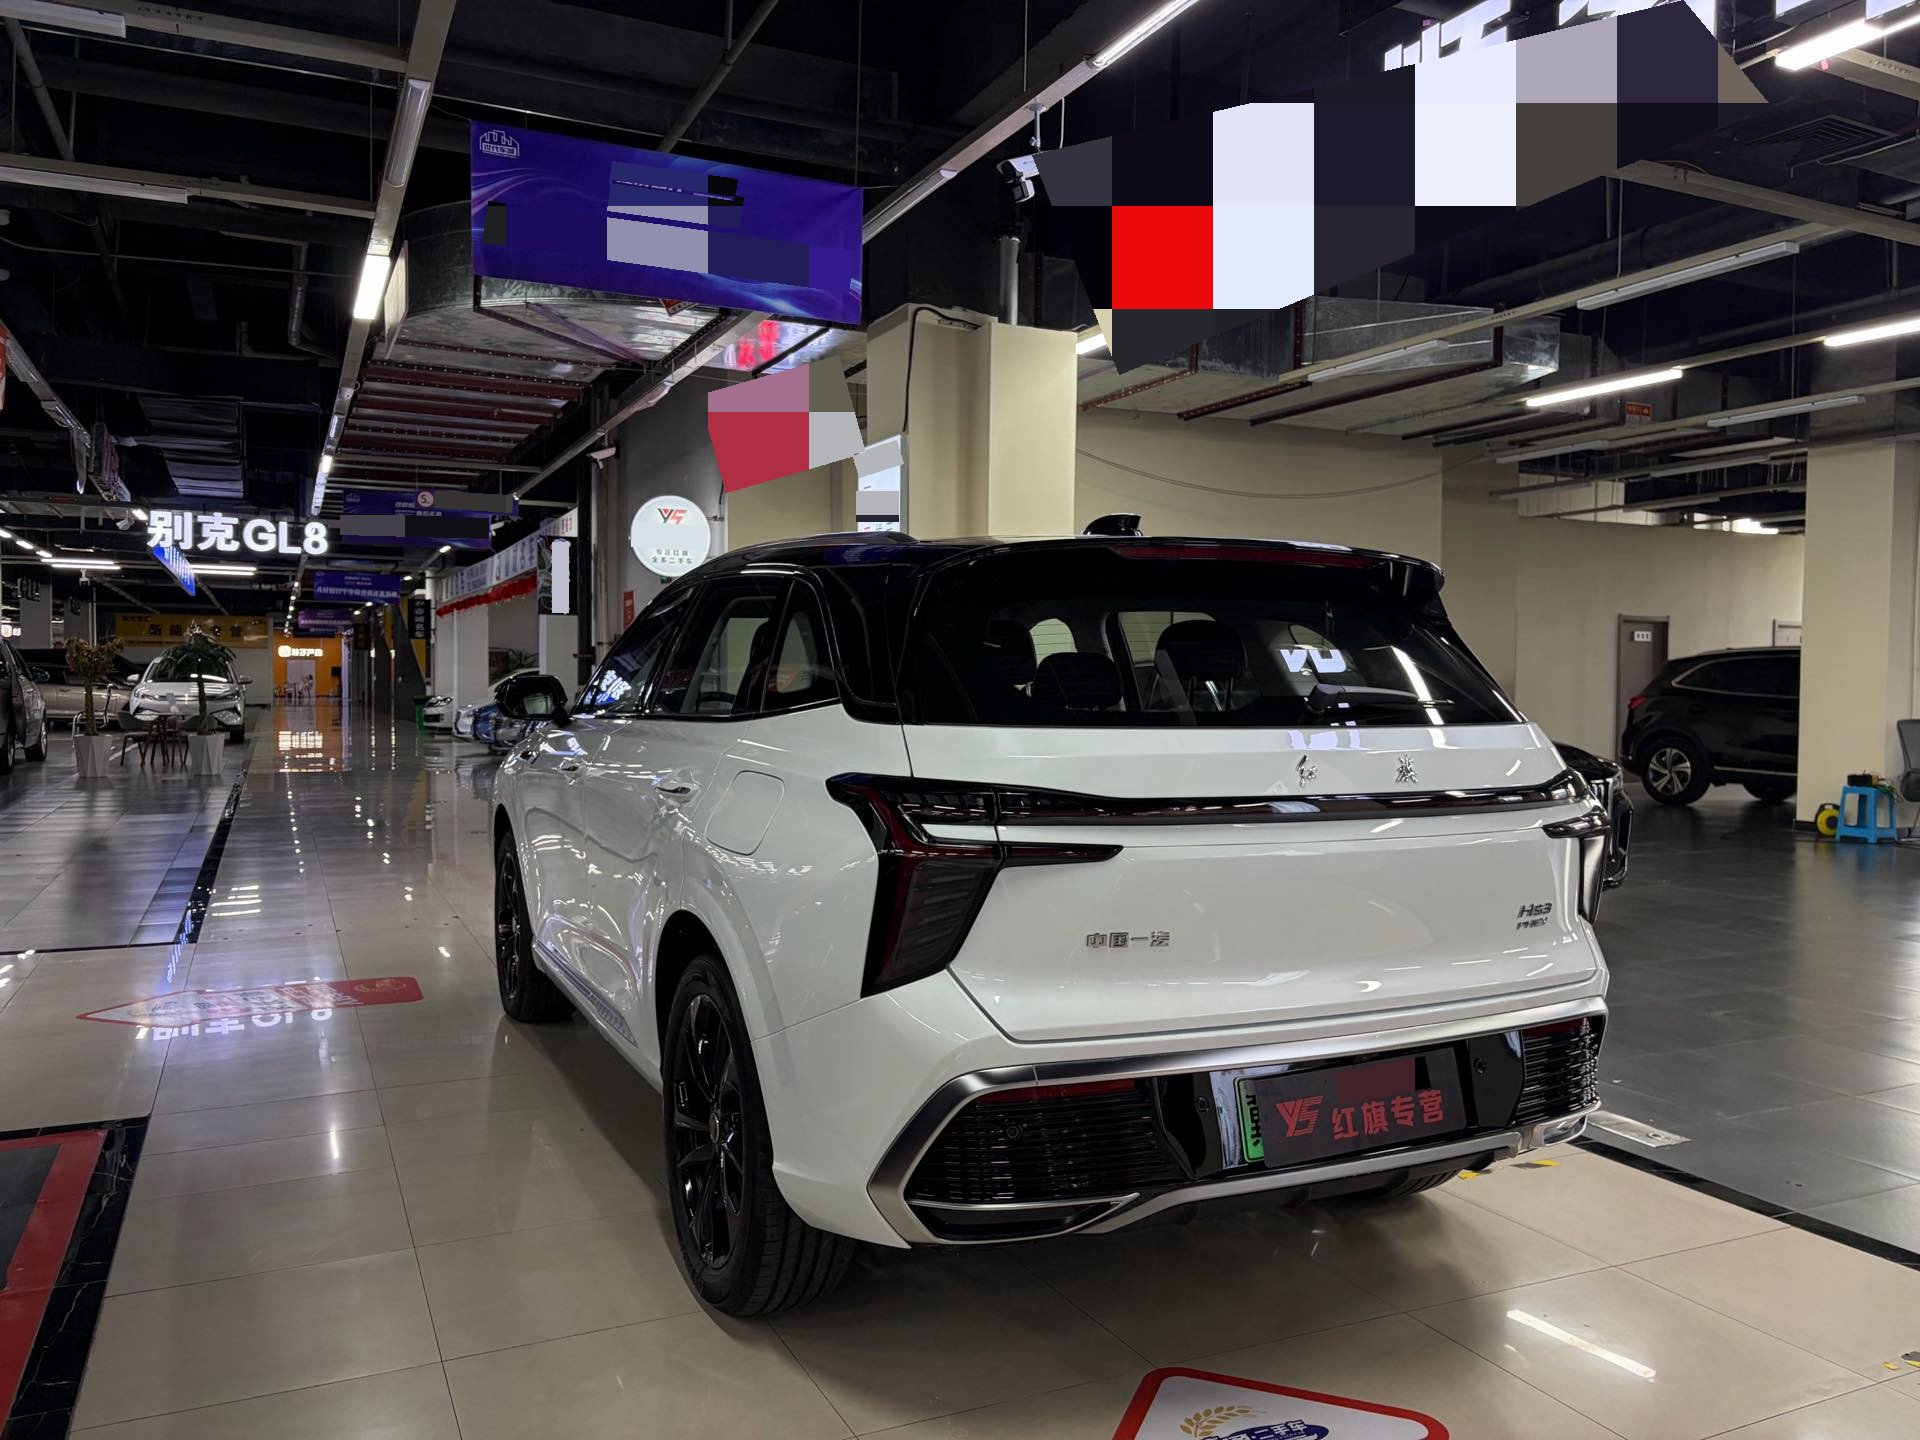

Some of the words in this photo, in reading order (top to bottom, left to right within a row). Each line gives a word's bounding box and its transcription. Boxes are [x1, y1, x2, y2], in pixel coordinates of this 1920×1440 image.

[147, 511, 328, 555] 别克GL8
[1086, 931, 1171, 949] 中国一汽
[1330, 1089, 1444, 1141] 红旗专营
